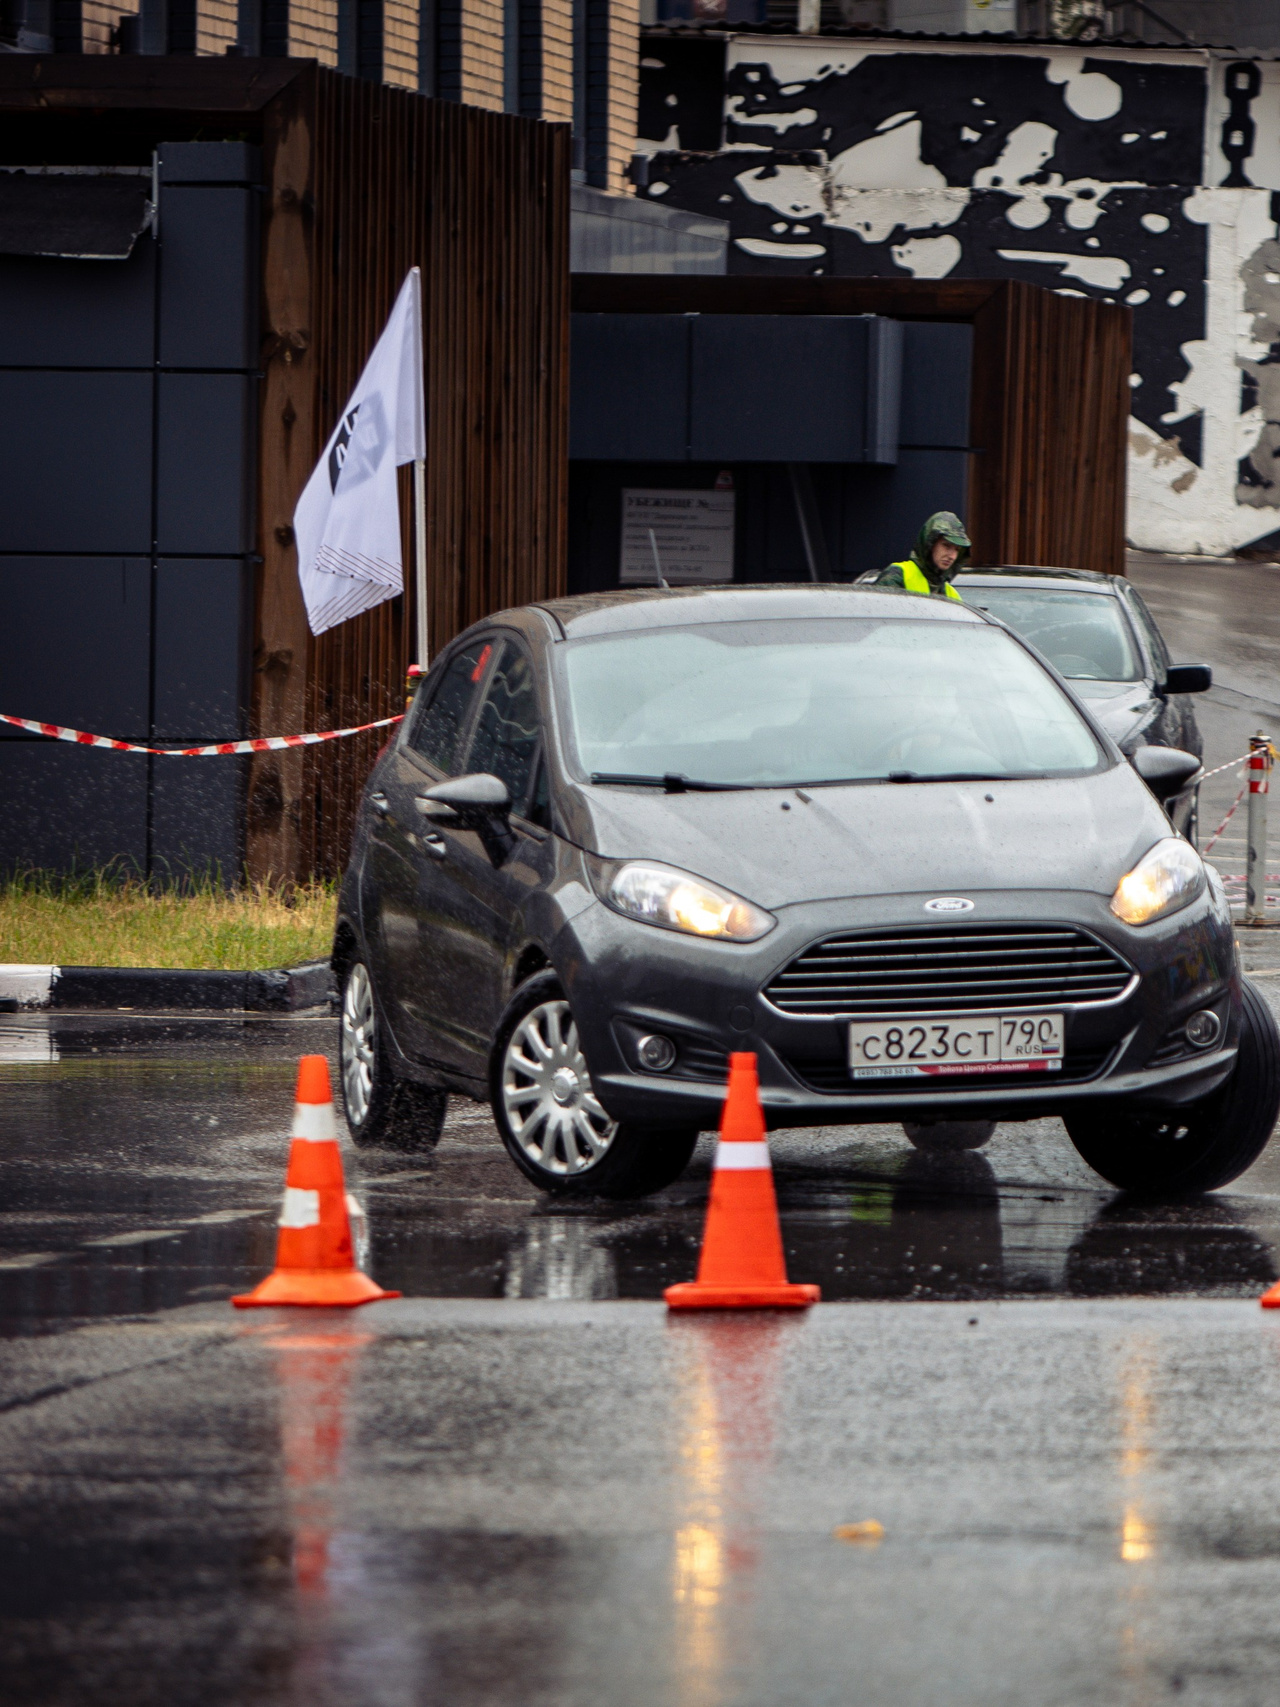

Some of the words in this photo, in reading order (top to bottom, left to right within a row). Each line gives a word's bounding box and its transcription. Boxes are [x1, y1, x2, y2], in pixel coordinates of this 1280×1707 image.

[1003, 1019, 1053, 1046] 790
[1015, 1044, 1041, 1055] RUS
[963, 1064, 986, 1073] Центр
[987, 1061, 1029, 1071] Сокольники
